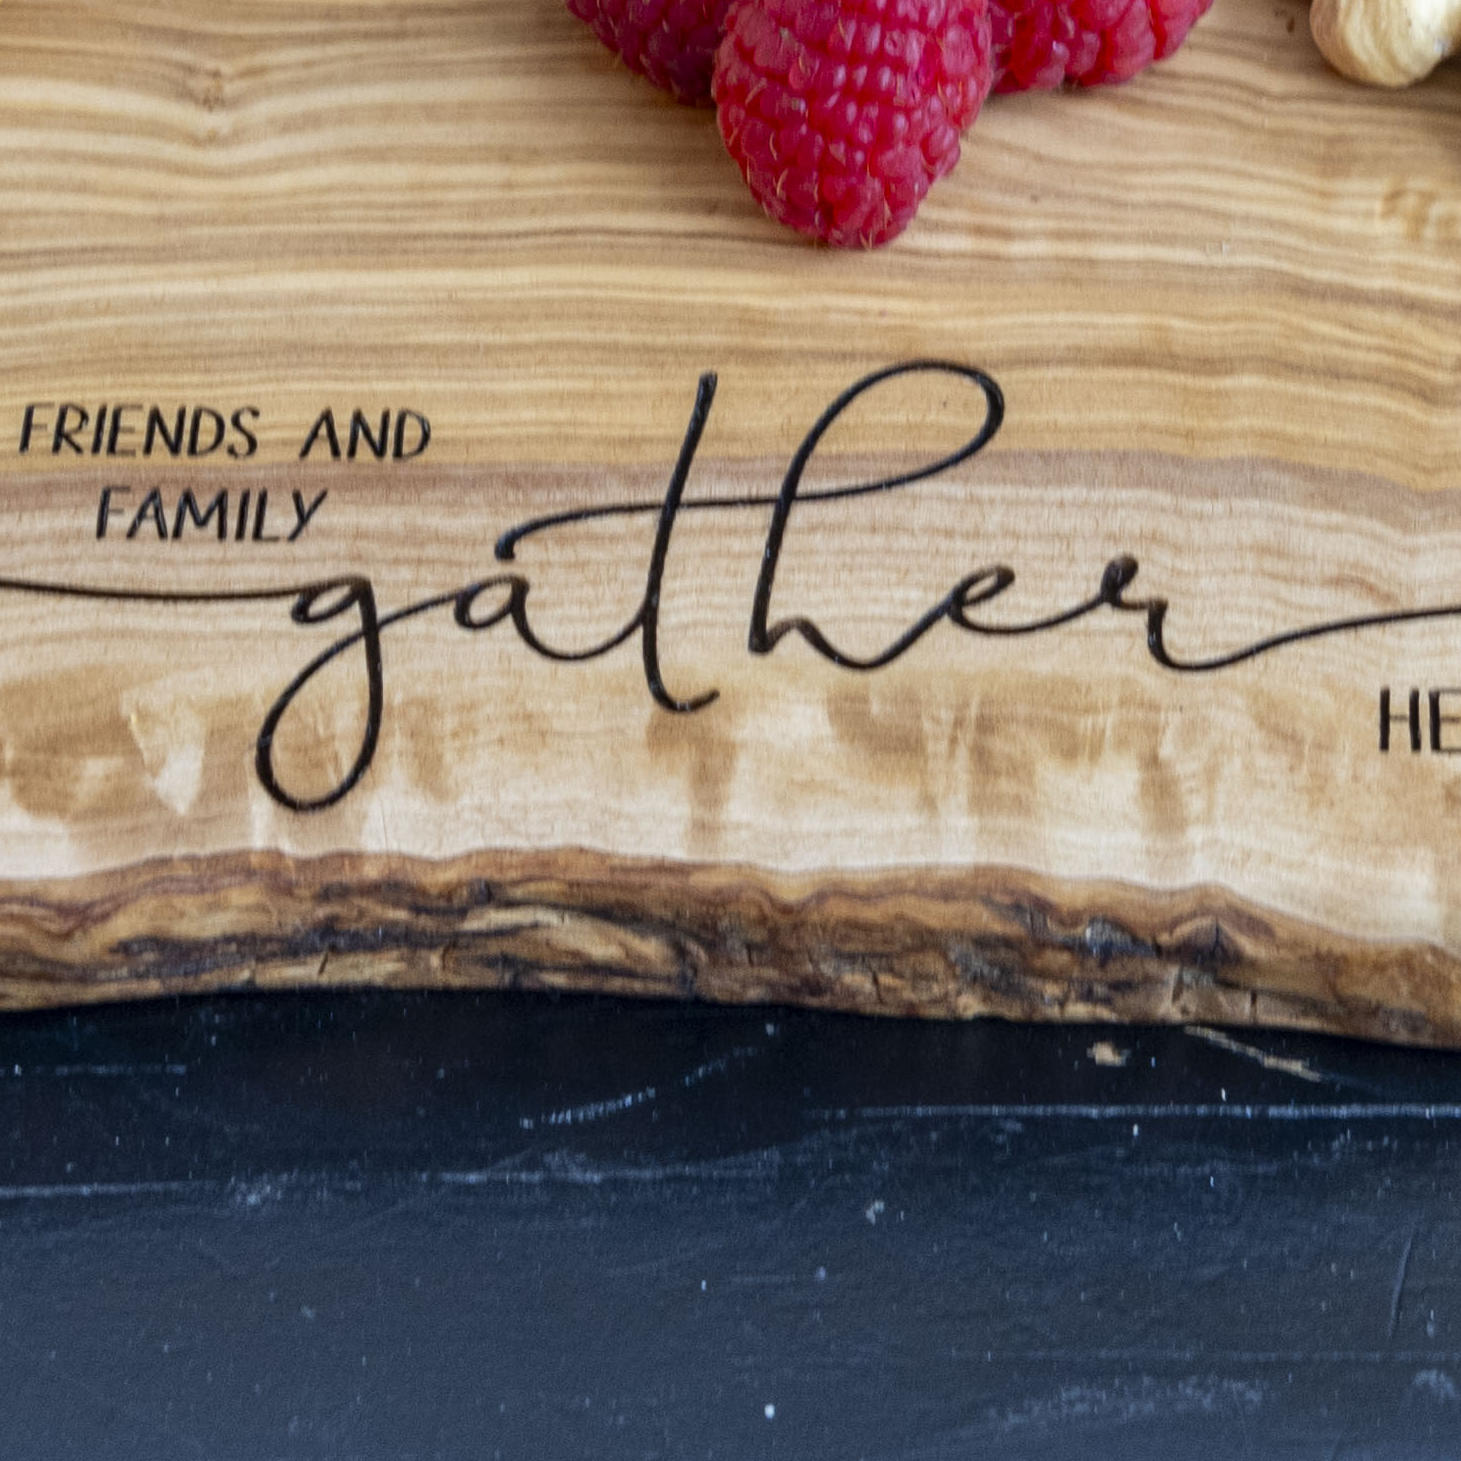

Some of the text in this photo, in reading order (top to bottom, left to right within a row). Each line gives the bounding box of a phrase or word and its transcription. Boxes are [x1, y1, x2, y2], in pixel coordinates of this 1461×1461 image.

[18, 402, 433, 462] FRIENDS AND
[95, 484, 330, 543] FAMILY
